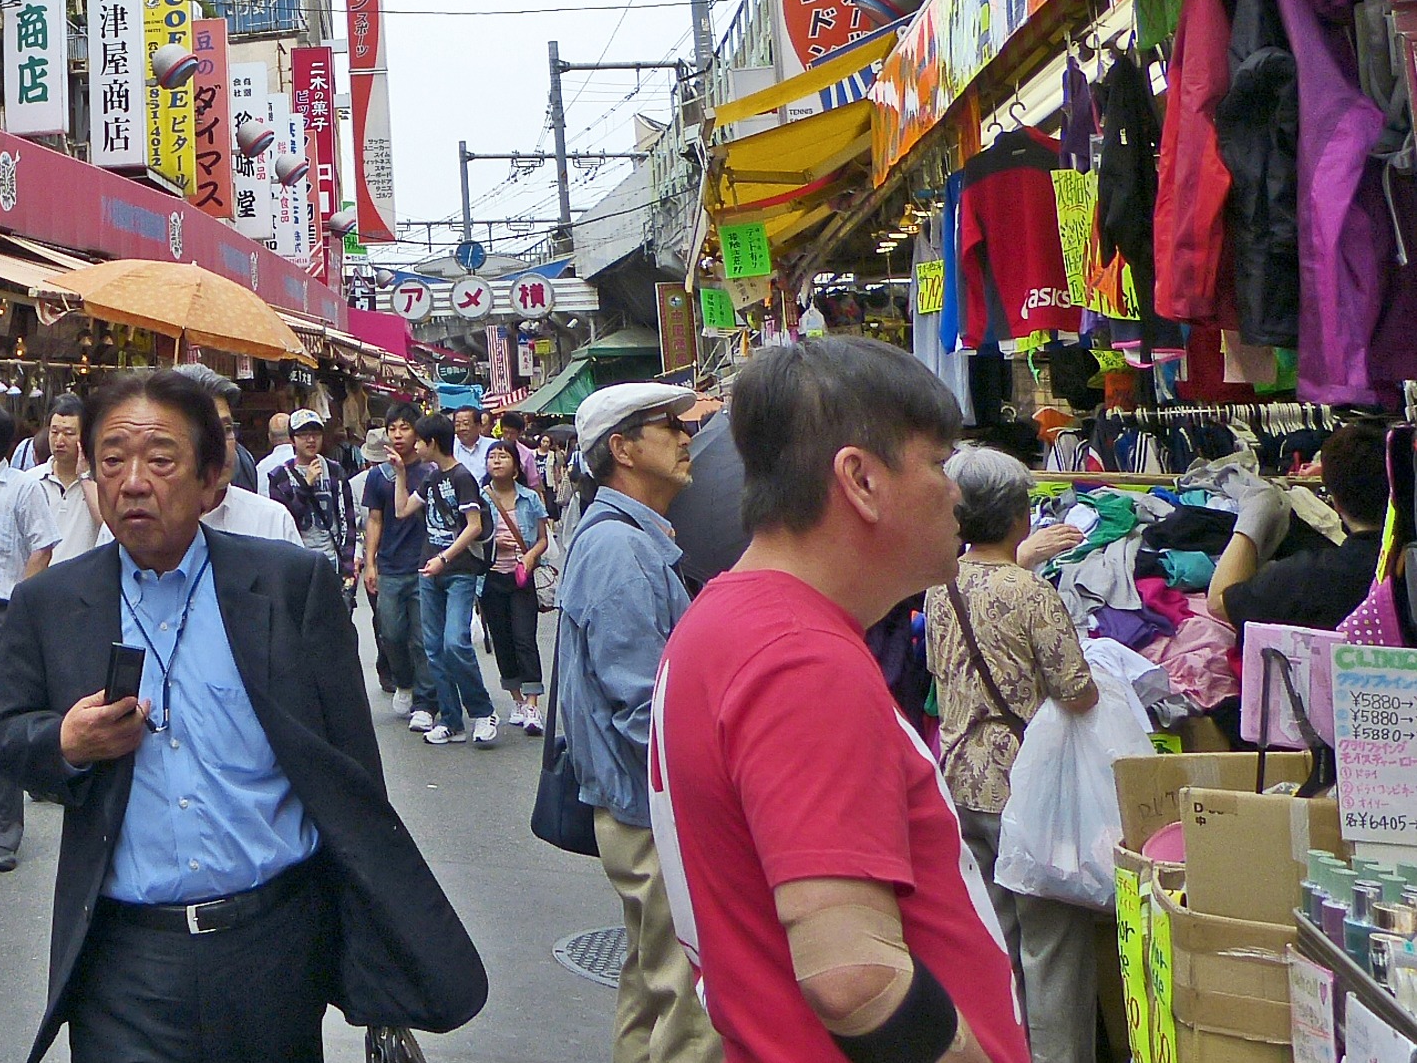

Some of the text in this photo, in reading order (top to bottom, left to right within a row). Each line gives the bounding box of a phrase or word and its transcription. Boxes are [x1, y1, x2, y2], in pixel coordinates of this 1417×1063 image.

[355, 12, 369, 58] スポーツ
[194, 30, 215, 76] 豆の
[309, 62, 329, 133] 二木の菓子
[788, 108, 814, 116] TENNIS
[194, 84, 224, 208] ダイマス
[400, 282, 546, 314] アメ横
[1027, 287, 1072, 309] asics
[1350, 691, 1401, 710] ¥5880
[1349, 708, 1399, 726] ¥5880
[1352, 724, 1402, 743] ¥5880
